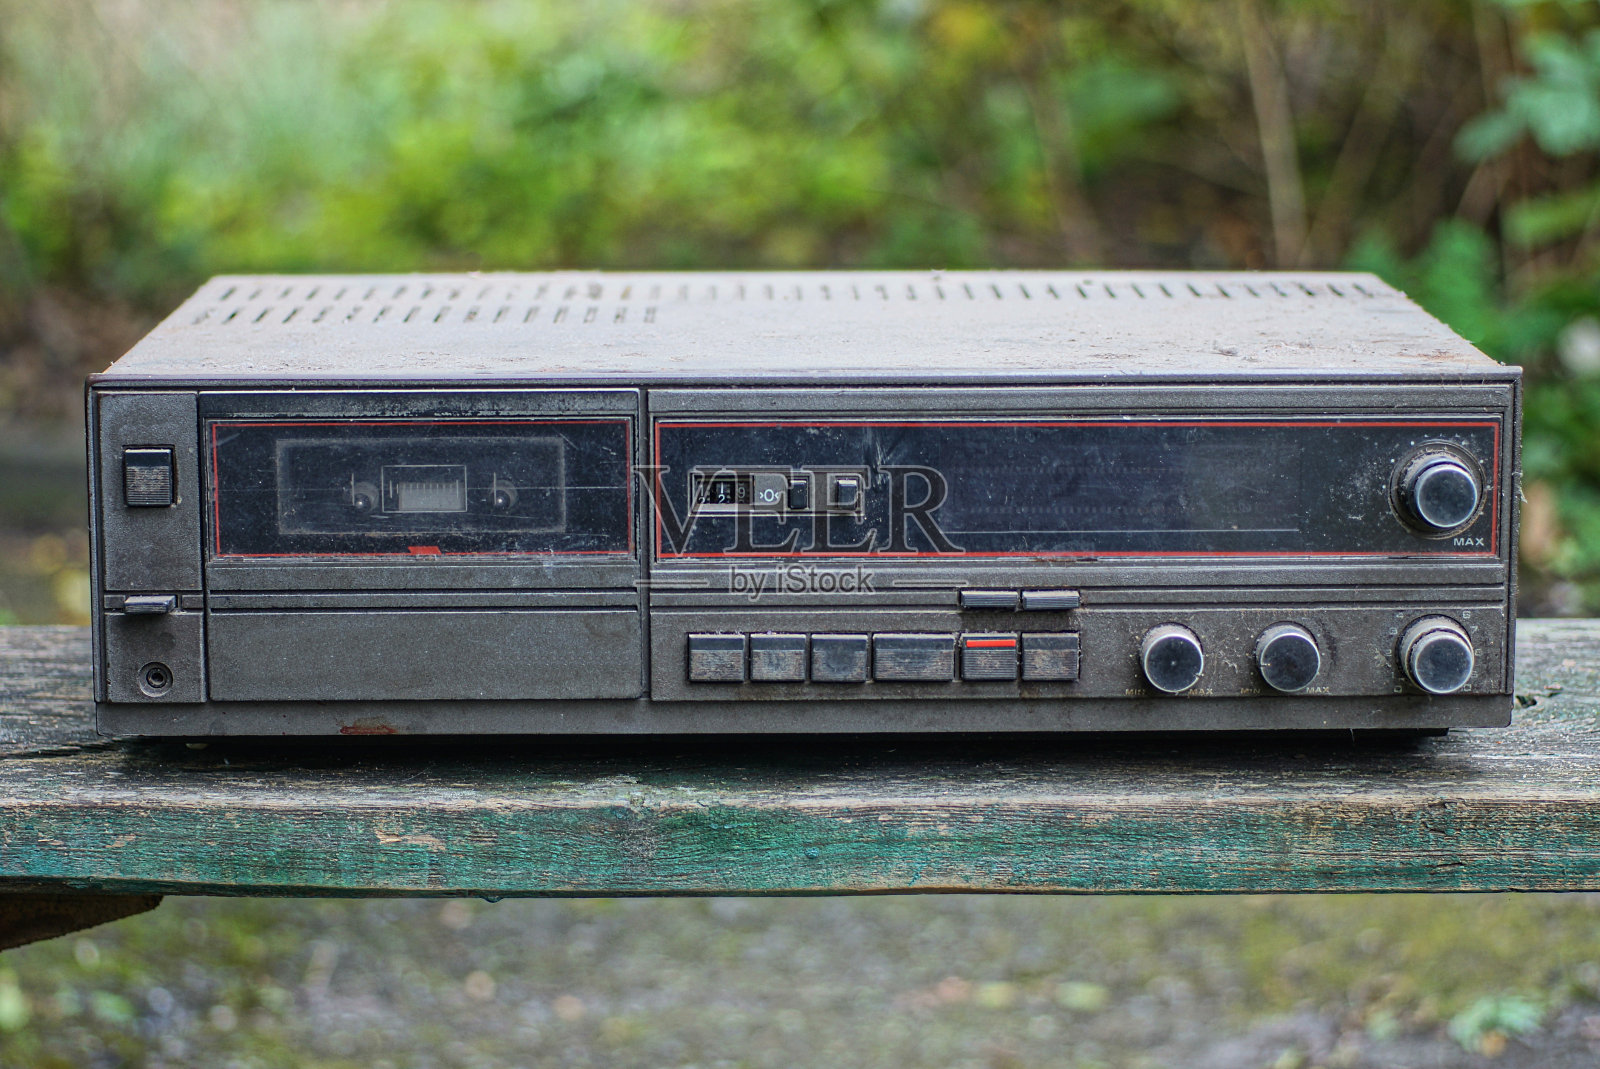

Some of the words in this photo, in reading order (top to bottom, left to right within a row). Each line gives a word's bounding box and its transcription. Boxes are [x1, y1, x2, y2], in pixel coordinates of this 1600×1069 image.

[1453, 537, 1485, 546] MAX
[1188, 688, 1213, 696] MAX
[1240, 687, 1261, 695] MIN
[1306, 686, 1330, 694] MAX
